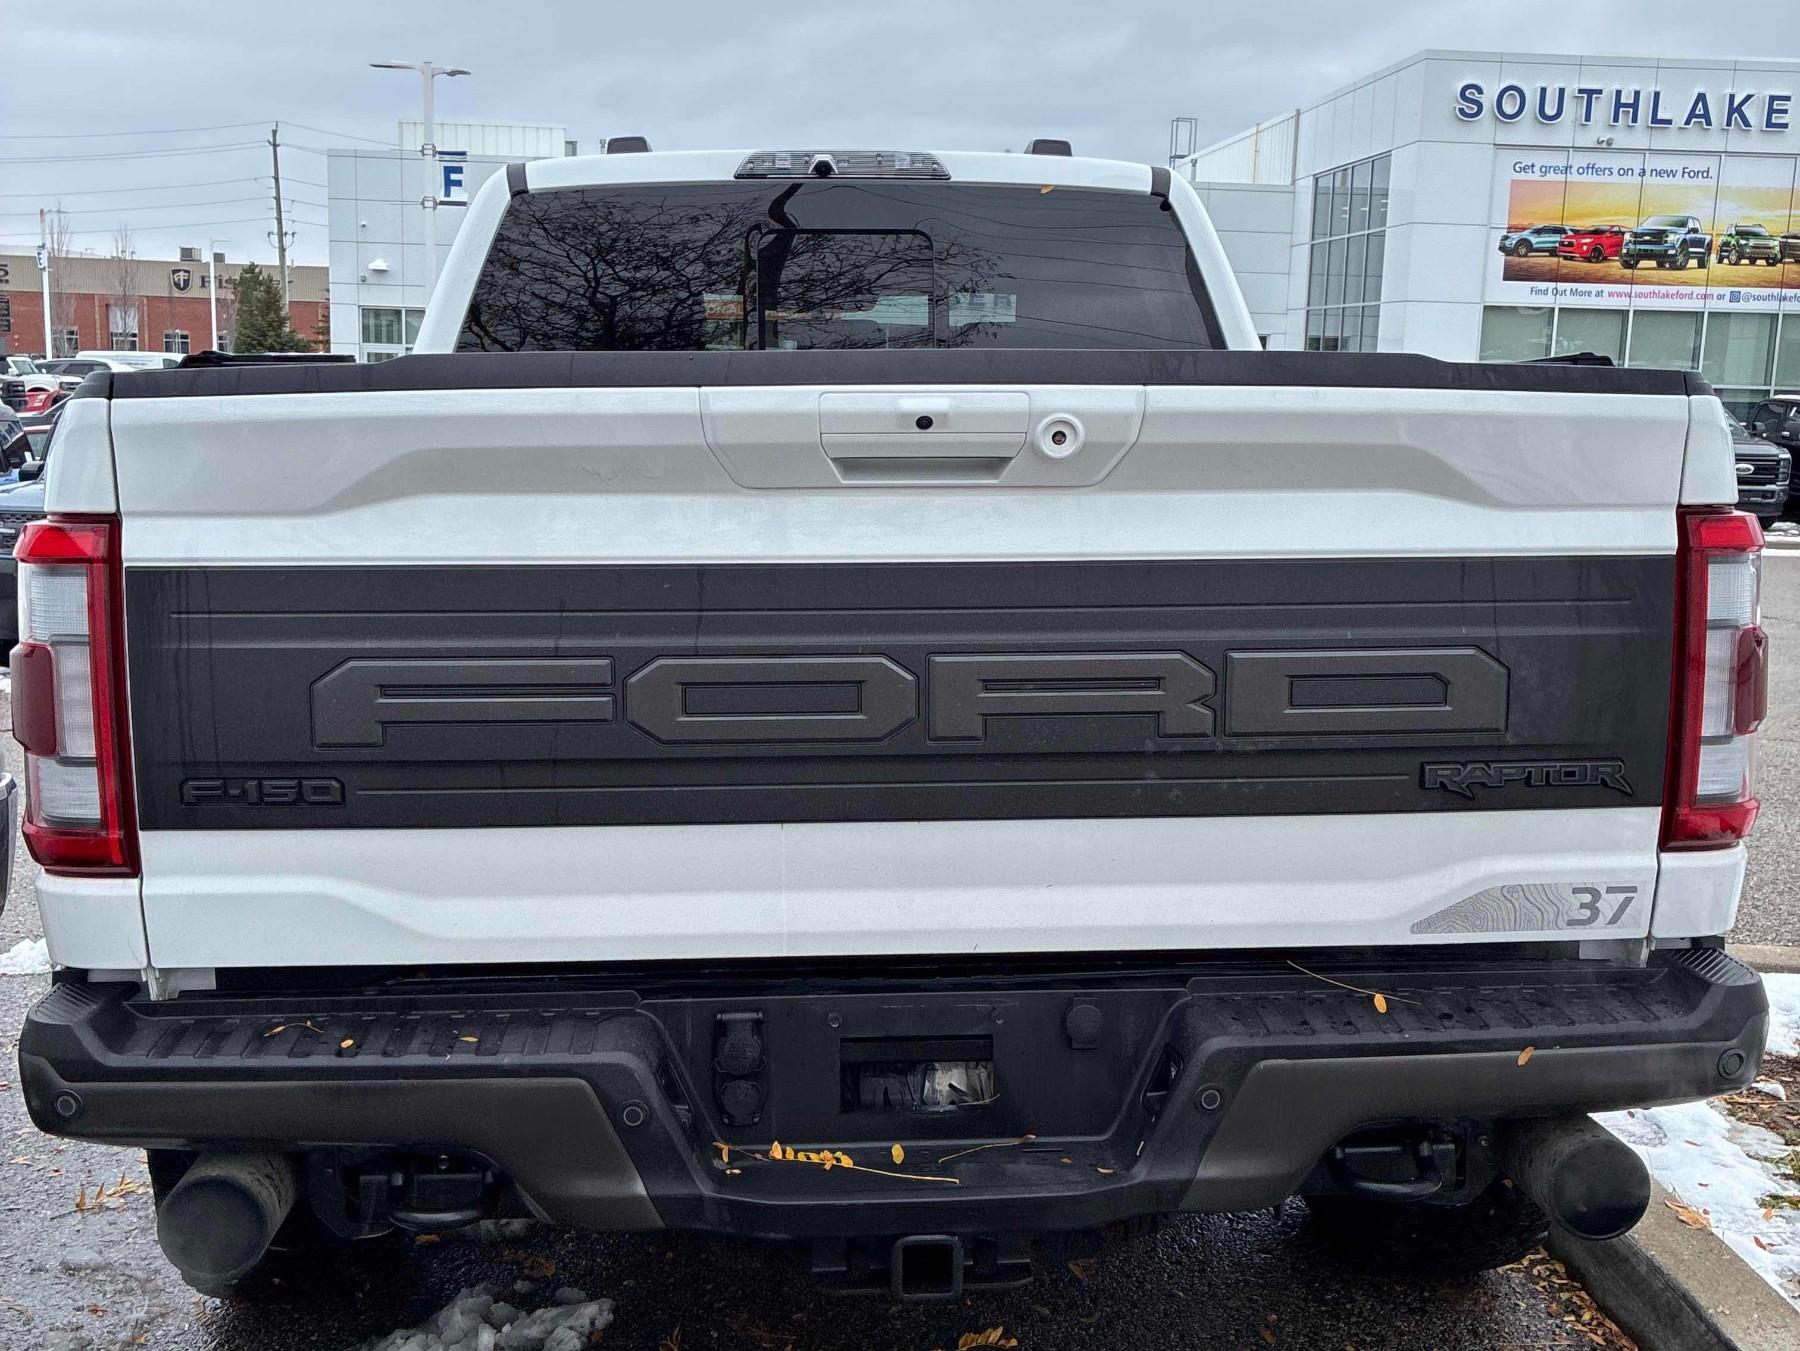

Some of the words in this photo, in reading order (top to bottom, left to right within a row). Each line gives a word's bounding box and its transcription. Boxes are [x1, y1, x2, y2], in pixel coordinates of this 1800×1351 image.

[1456, 82, 1792, 130] SOUTHLAKE
[443, 166, 463, 197] F
[1513, 161, 1536, 174] Get
[1540, 163, 1572, 177] great
[1576, 163, 1613, 177] offers
[1617, 166, 1634, 177] on
[1638, 167, 1646, 177] a
[1650, 167, 1677, 179] new
[1681, 166, 1713, 180] Ford.
[1530, 286, 1549, 296] Find
[1552, 287, 1567, 297] Out
[1569, 288, 1593, 298] More
[1594, 289, 1604, 298] at
[1607, 289, 1714, 301] www.southlakeford.com
[1716, 293, 1726, 301] or
[310, 646, 1510, 748] FORD
[180, 777, 346, 806] F-150
[1419, 758, 1634, 800] RAPTOR
[1566, 886, 1638, 927] 37
